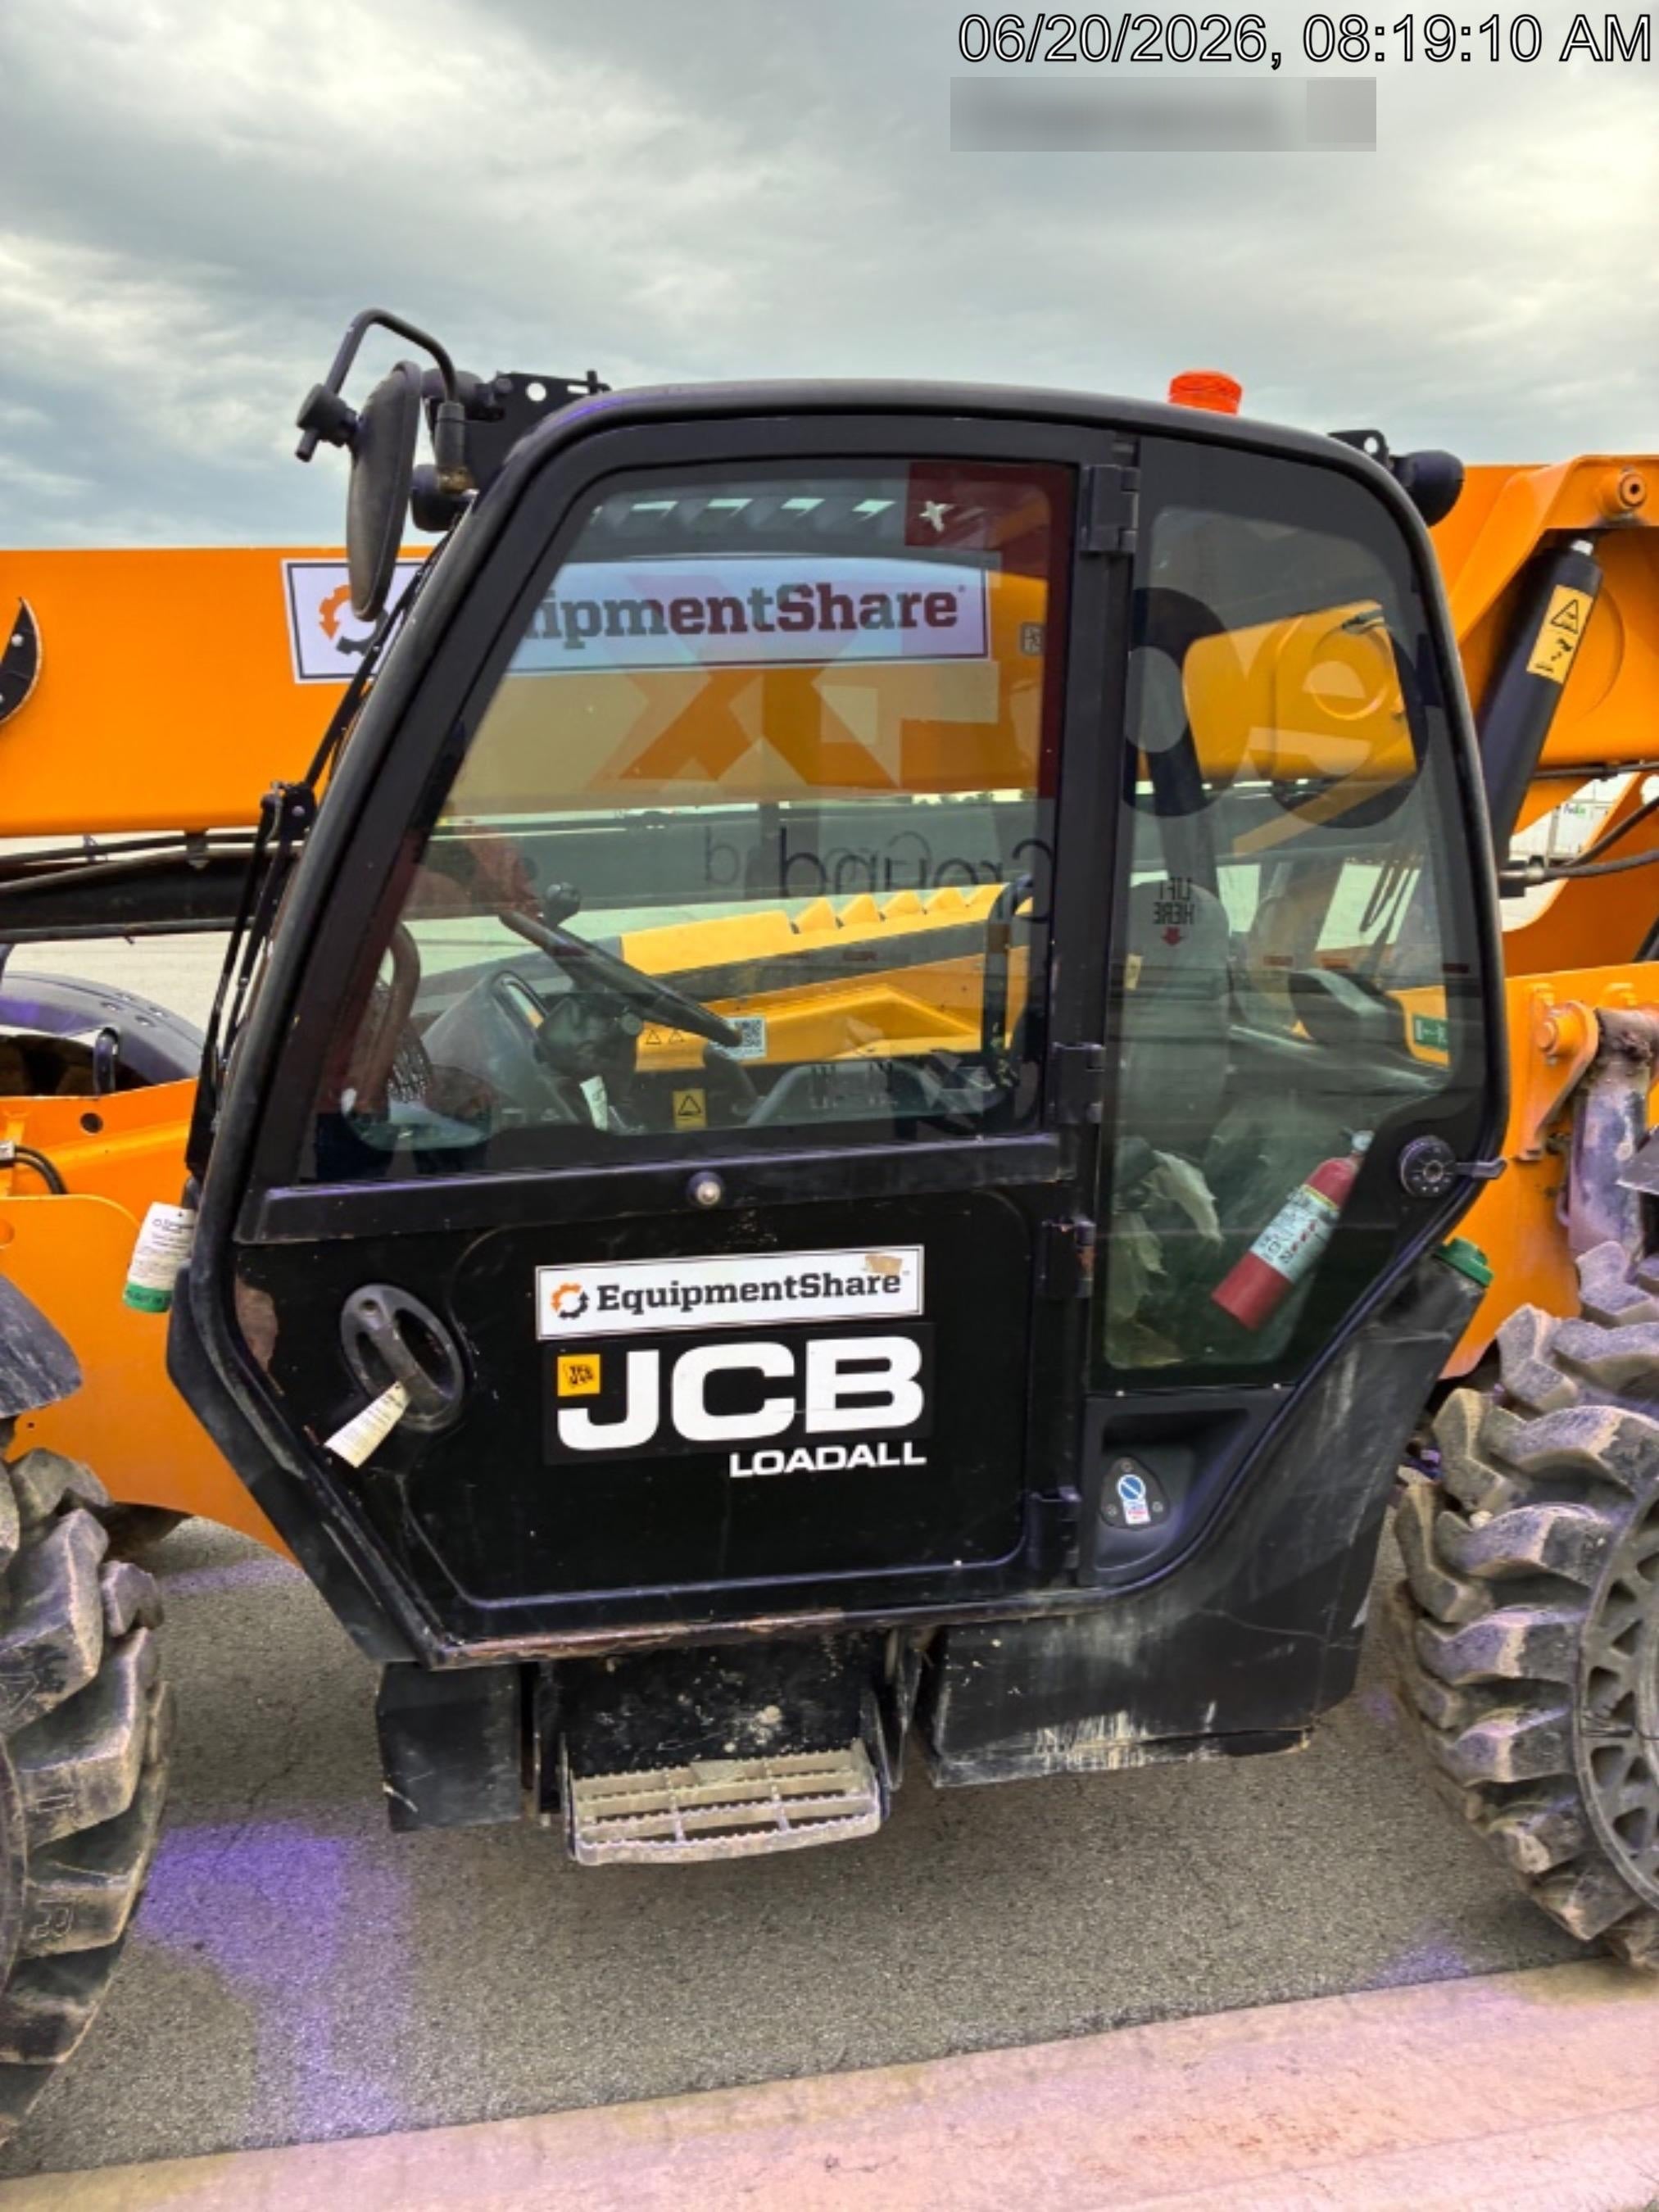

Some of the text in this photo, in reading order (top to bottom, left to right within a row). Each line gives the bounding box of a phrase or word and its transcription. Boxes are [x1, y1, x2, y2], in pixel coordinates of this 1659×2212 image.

[596, 1272, 901, 1315] EquipmentShare
[557, 1335, 925, 1451] JCB
[729, 1442, 927, 1478] LOADALL
